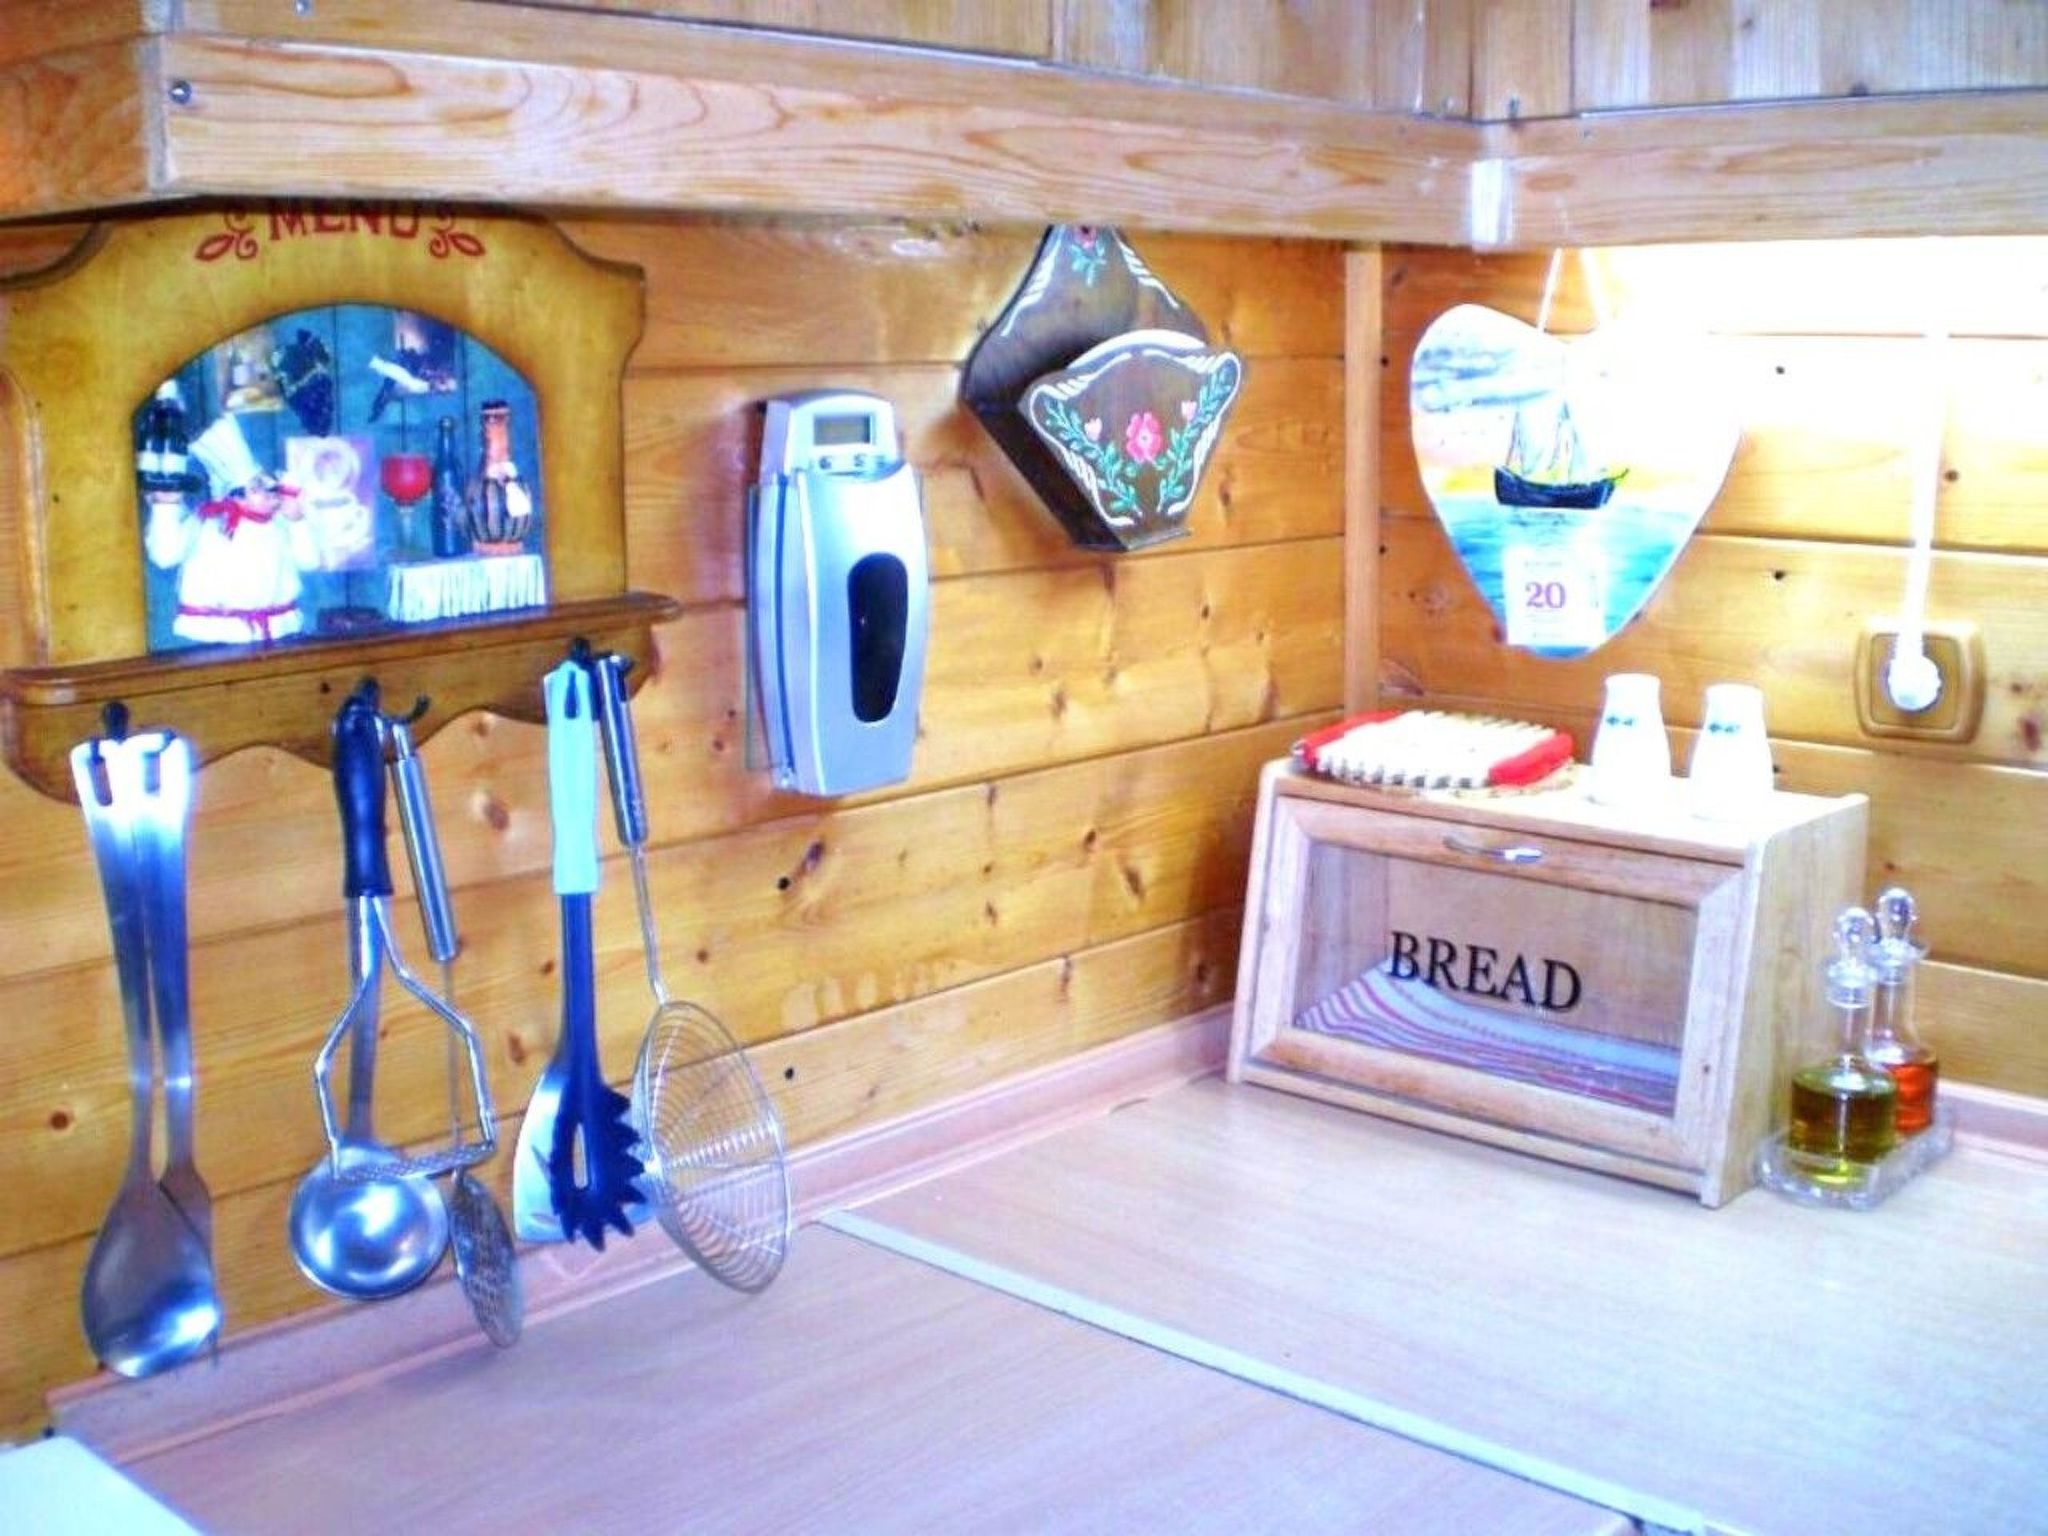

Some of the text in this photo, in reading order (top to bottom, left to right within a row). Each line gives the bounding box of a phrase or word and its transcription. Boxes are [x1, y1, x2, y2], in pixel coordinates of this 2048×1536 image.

[269, 203, 419, 239] MENU
[1525, 581, 1566, 608] 20
[1389, 930, 1582, 1012] BREAD
